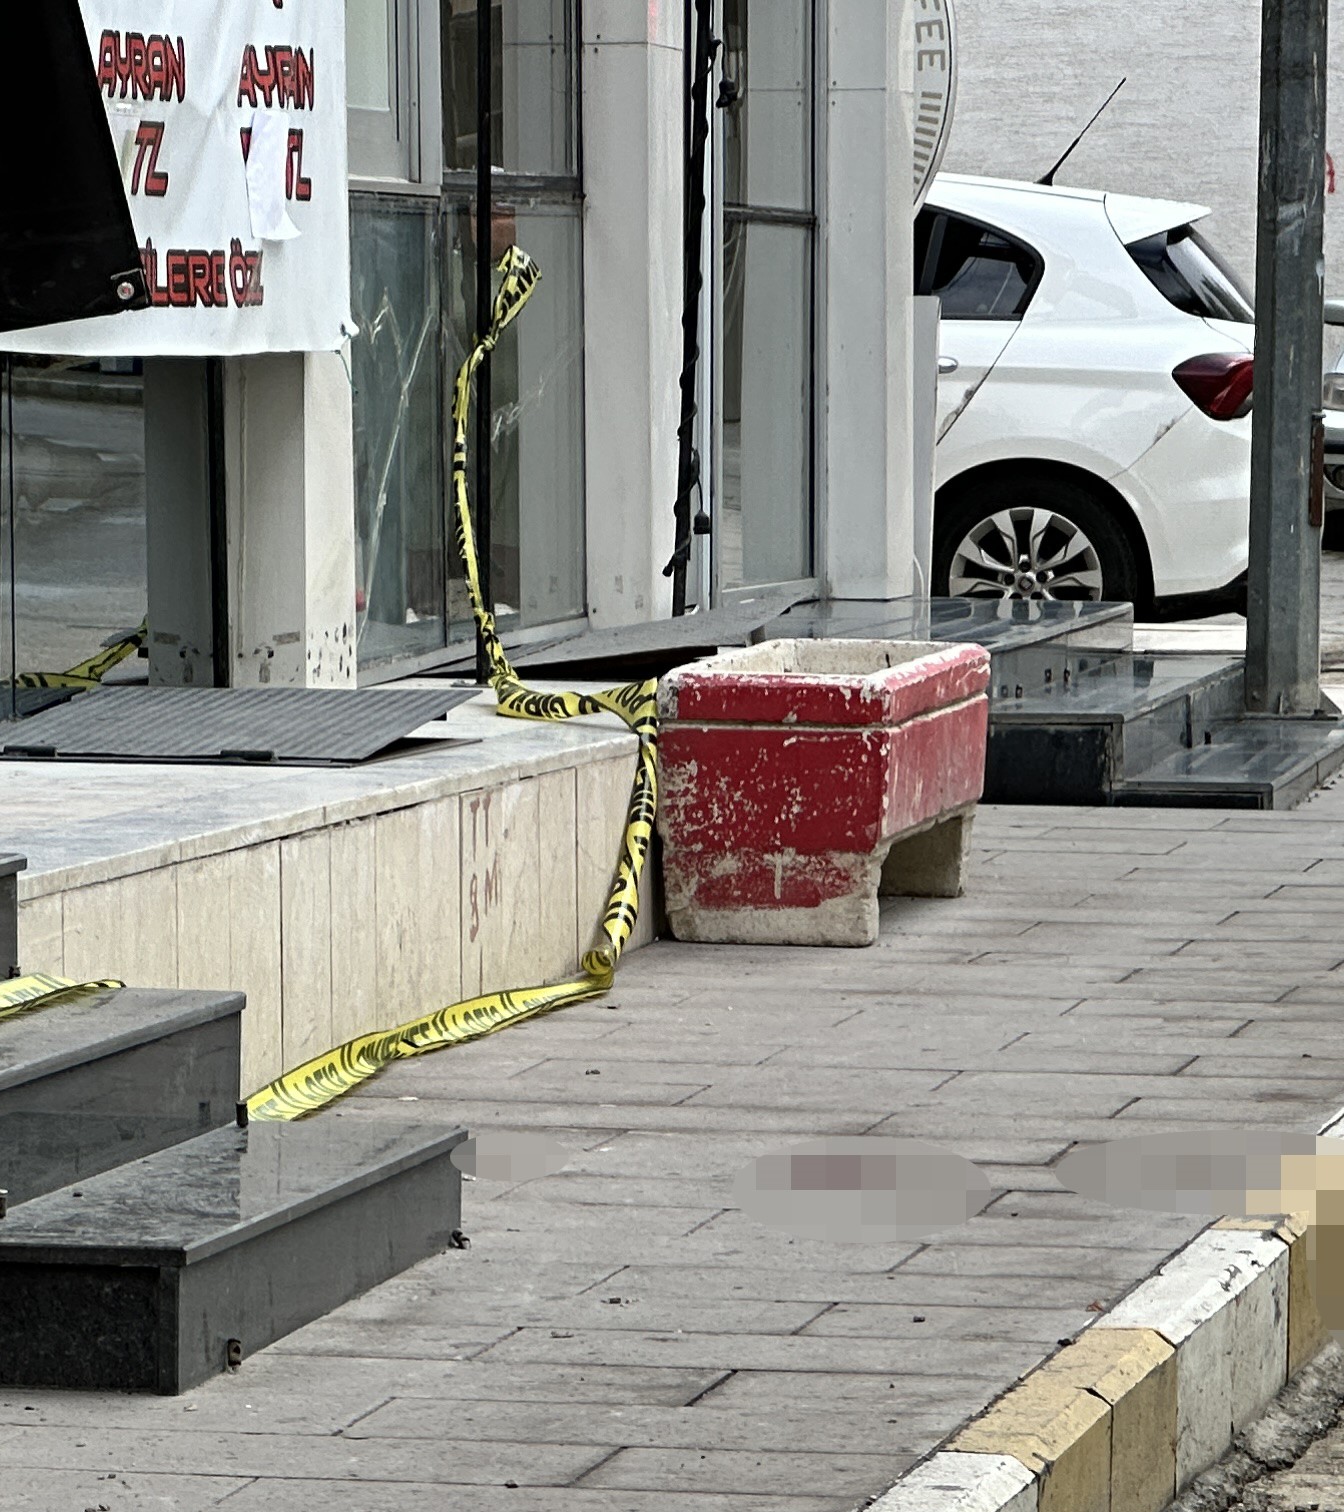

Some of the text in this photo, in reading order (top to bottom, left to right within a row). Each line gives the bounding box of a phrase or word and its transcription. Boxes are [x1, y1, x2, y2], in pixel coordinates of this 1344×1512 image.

[97, 29, 185, 103] AYRAN
[914, 0, 946, 71] EE
[131, 120, 169, 197] TL
[139, 236, 228, 308] İLERE
